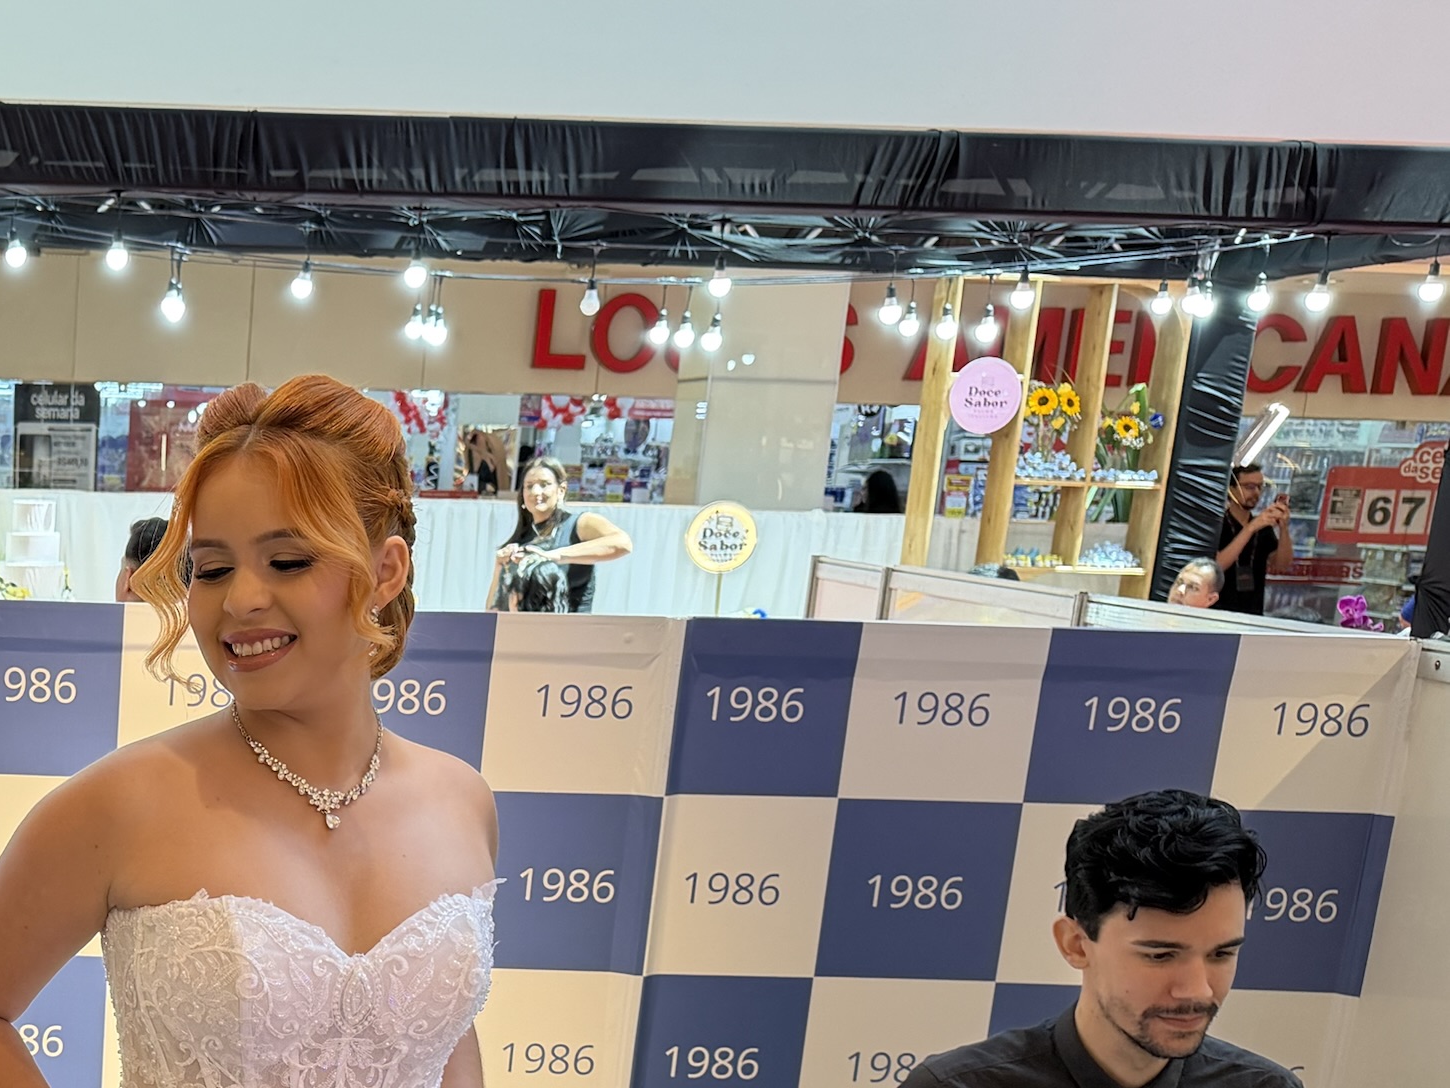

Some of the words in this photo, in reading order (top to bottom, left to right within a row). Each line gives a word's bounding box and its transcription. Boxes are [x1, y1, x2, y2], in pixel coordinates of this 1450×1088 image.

[963, 397, 1008, 408] Sabor
[967, 386, 1002, 397] Doce
[35, 406, 80, 419] semana
[1418, 449, 1444, 464] ce
[1419, 465, 1442, 480] se
[698, 539, 744, 551] Sabor
[702, 527, 740, 539] Doce
[163, 673, 232, 708] 198
[371, 678, 447, 716] 986
[536, 683, 634, 721] 1986
[705, 685, 805, 724] 1986
[893, 690, 992, 728] 1986
[1083, 695, 1183, 734] 1986
[1272, 701, 1372, 739] 1986
[519, 866, 616, 904] 1986
[684, 871, 781, 907] 1986
[867, 873, 964, 911] 1986
[18, 1024, 65, 1058] 86
[502, 1041, 596, 1077] 1986
[664, 1045, 760, 1081] 1986
[848, 1051, 916, 1083] 198
